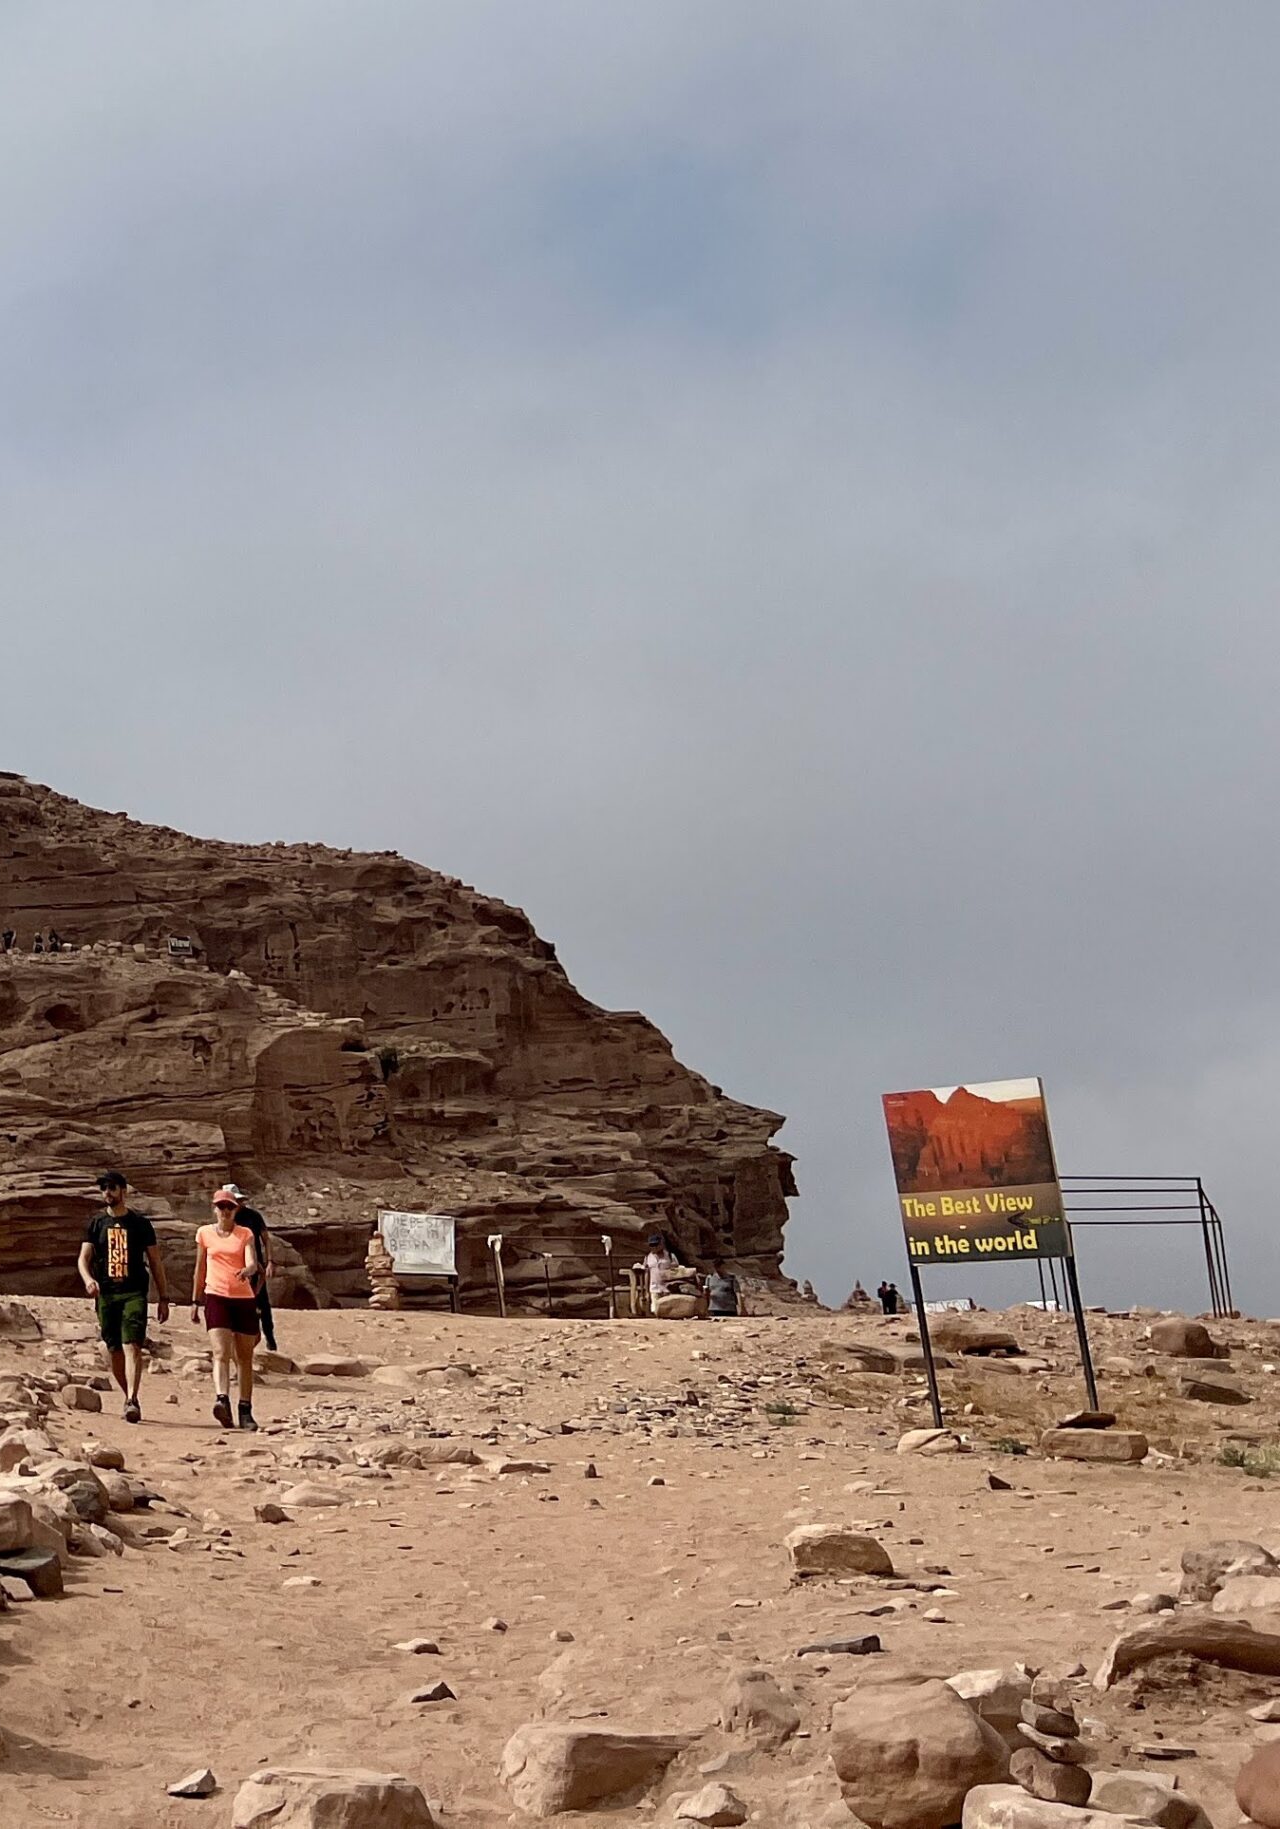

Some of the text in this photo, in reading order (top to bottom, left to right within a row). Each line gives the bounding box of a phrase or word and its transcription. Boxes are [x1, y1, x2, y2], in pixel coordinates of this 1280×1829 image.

[902, 1193, 1033, 1217] The Best View
[908, 1229, 1038, 1256] in the world
[108, 1249, 127, 1263] ISH
